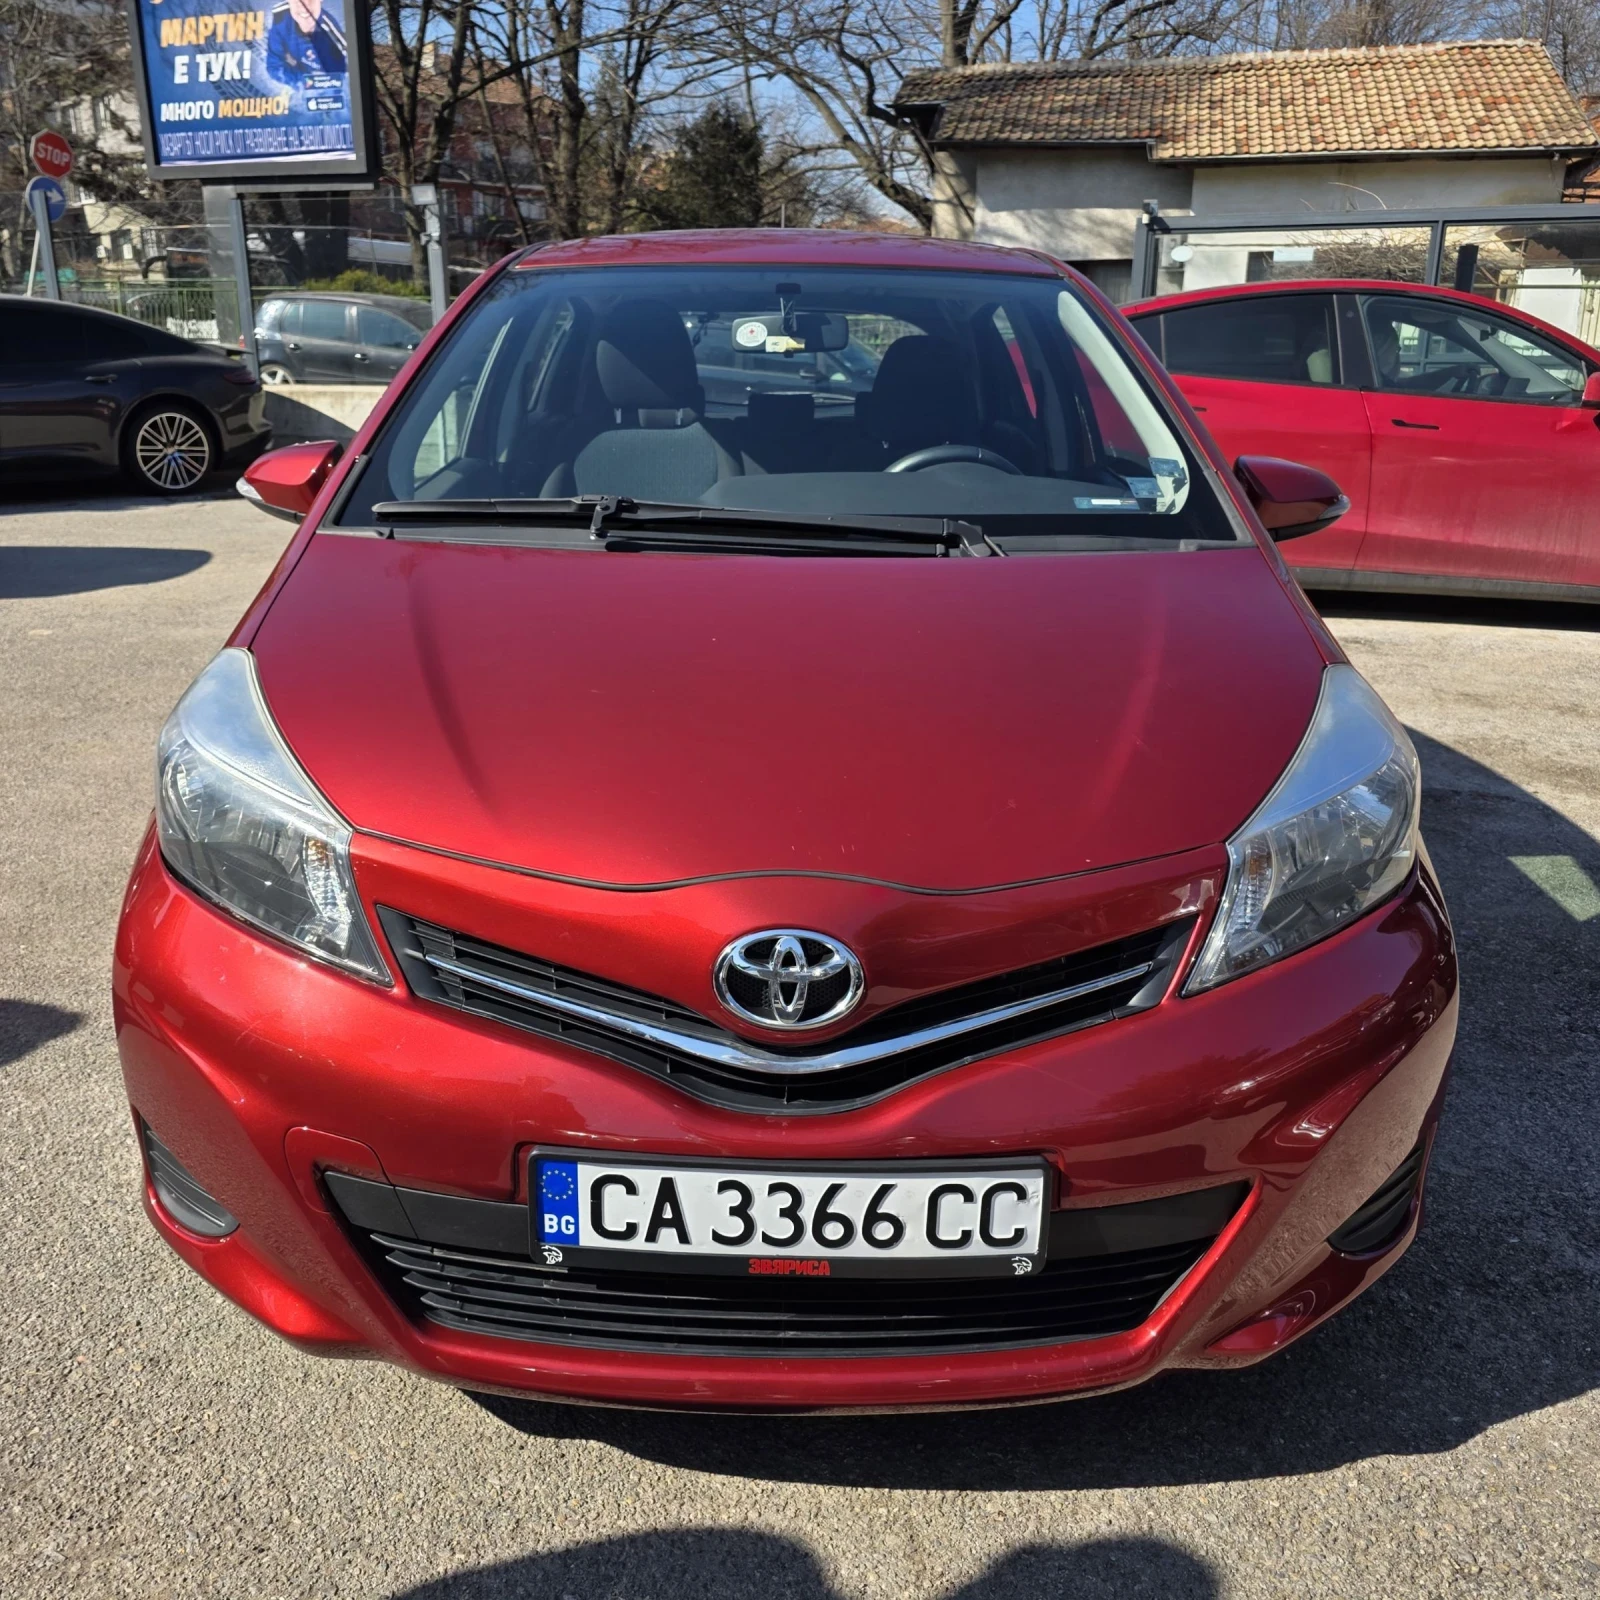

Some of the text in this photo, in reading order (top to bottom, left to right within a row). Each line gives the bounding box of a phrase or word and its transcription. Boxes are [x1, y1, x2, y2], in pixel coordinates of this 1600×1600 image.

[161, 11, 264, 48] МАРТИН
[174, 50, 251, 84] Е ТУК!
[161, 96, 289, 122] МНОГО МОЩНО!
[37, 142, 71, 167] STOP
[543, 1213, 576, 1235] BG
[590, 1173, 1028, 1249] CA 3366 CC
[748, 1257, 831, 1276] ЗВЯРИСА
